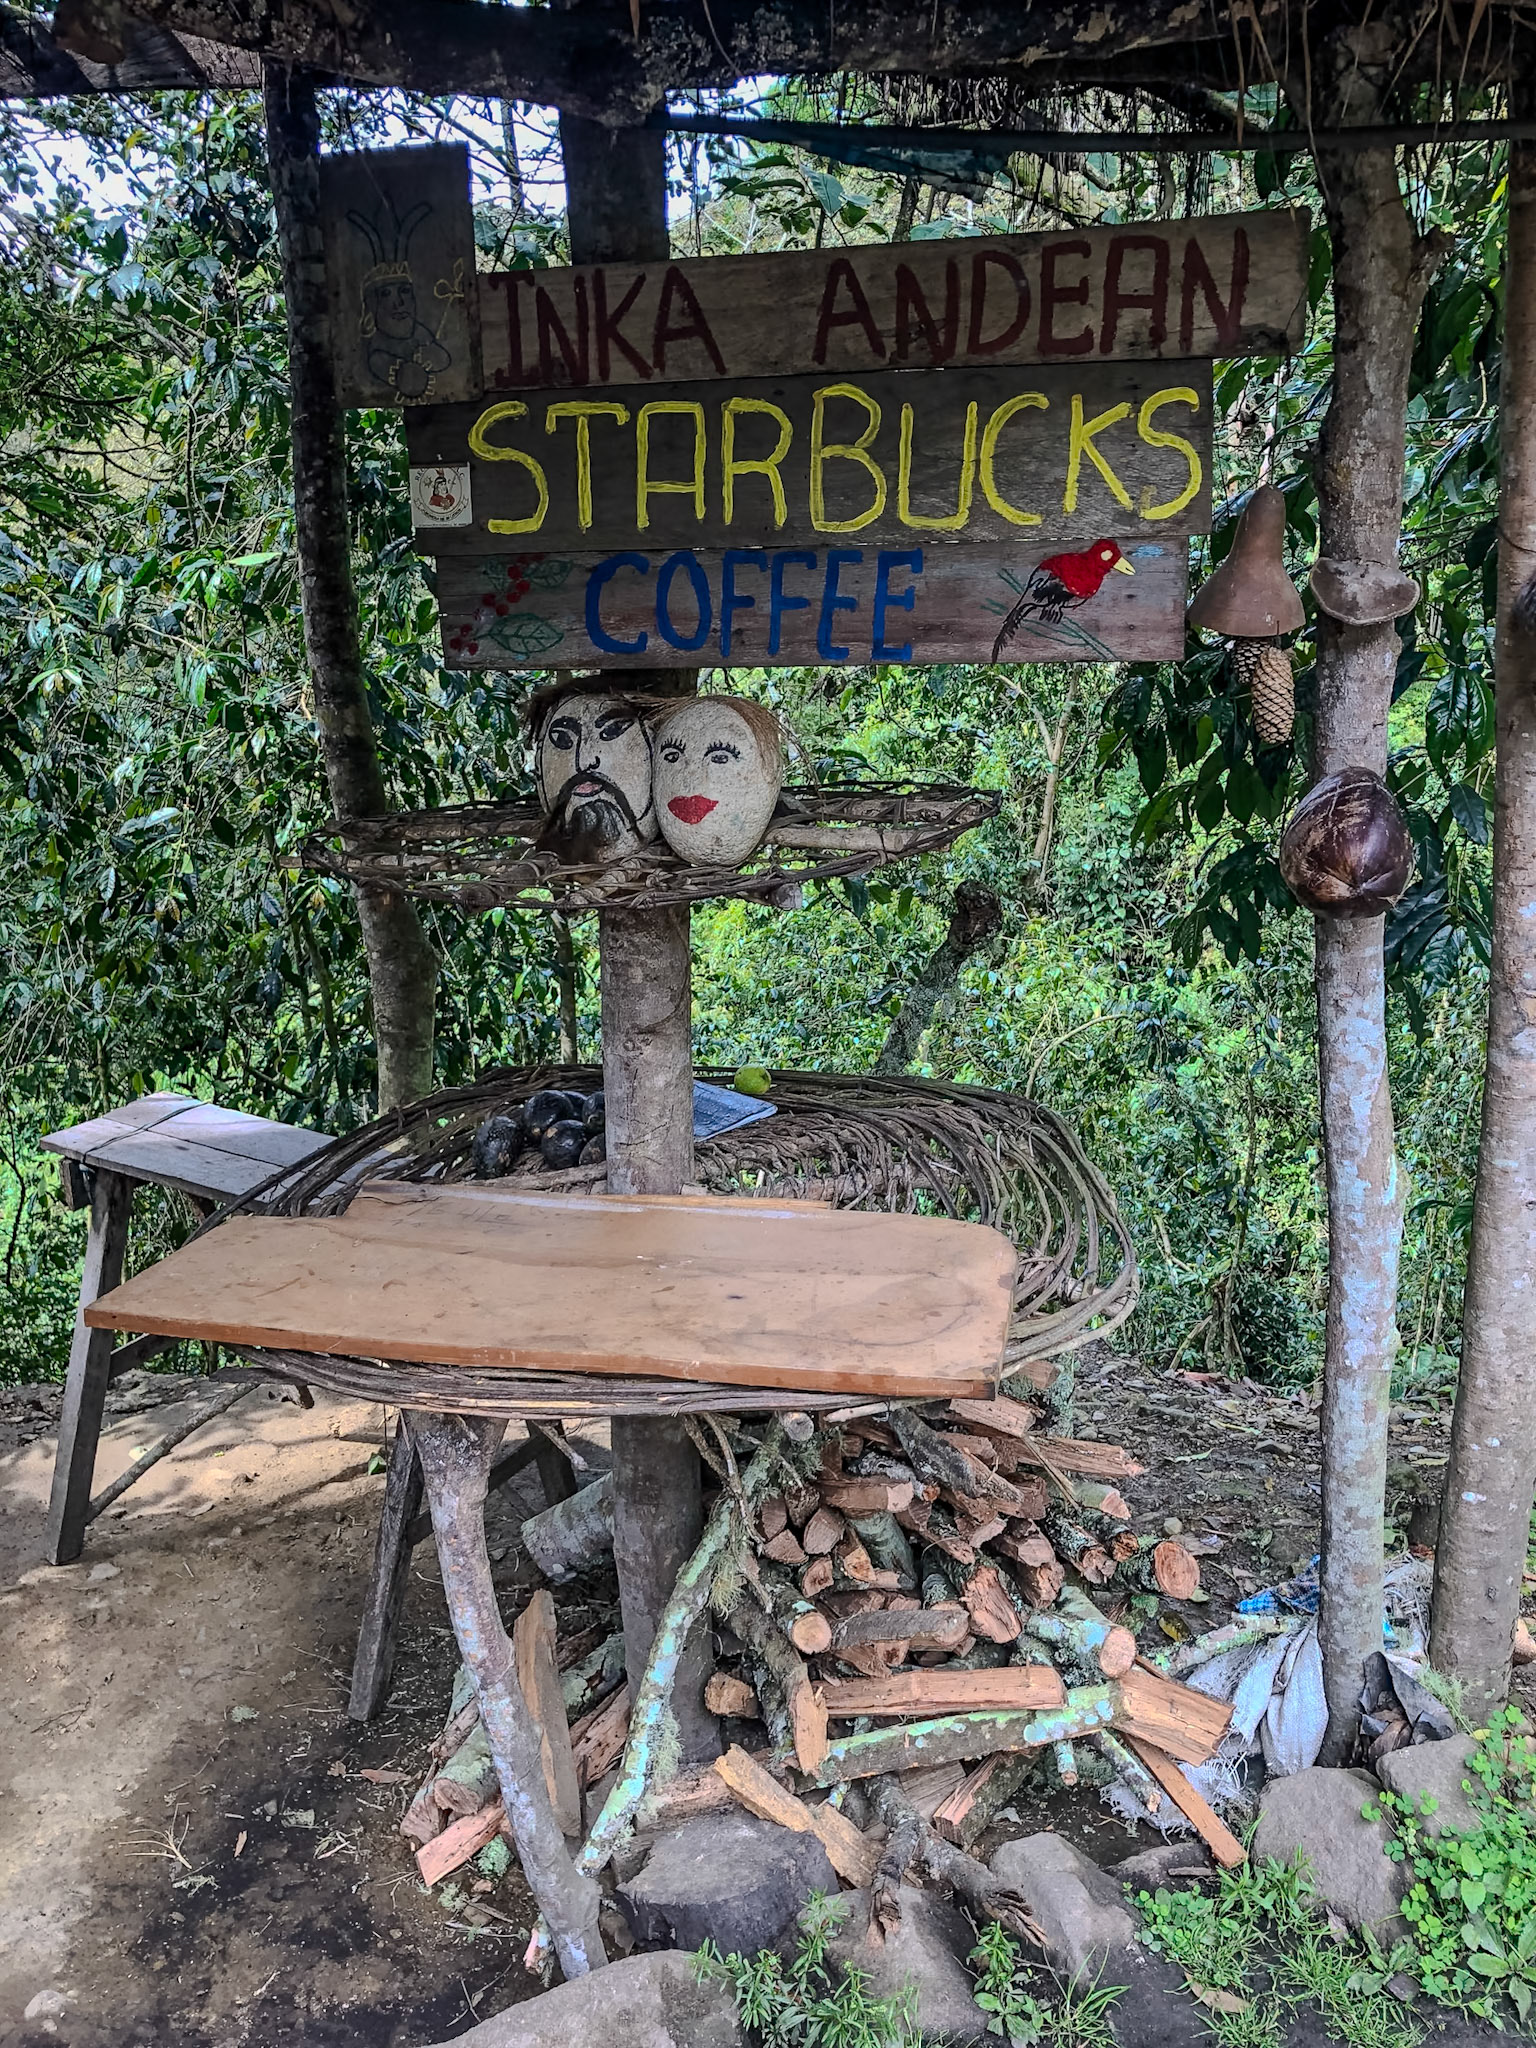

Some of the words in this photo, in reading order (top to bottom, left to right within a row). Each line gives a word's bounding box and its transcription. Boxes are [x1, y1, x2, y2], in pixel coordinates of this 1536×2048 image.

[488, 266, 728, 388] INKA
[811, 227, 1250, 366] ANDEAN
[467, 383, 1204, 535] STARBUCKS
[585, 549, 924, 662] COFFEE
